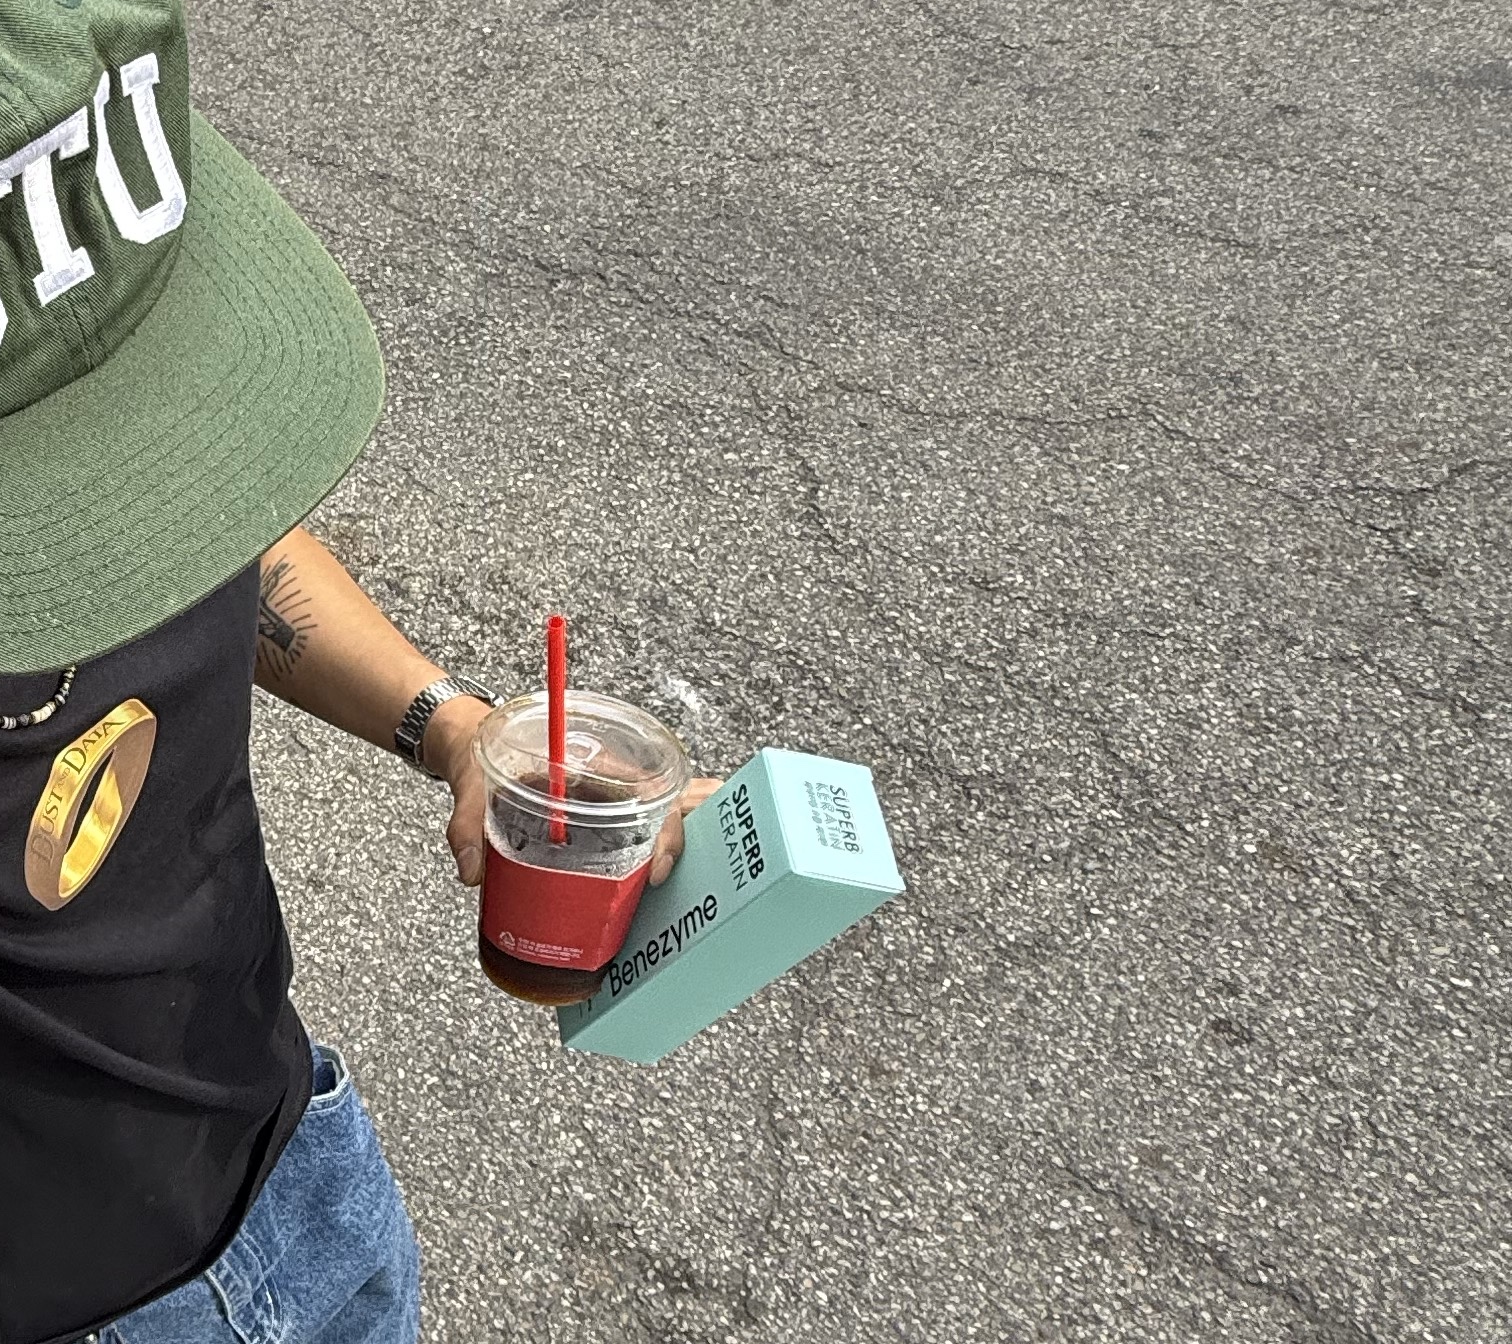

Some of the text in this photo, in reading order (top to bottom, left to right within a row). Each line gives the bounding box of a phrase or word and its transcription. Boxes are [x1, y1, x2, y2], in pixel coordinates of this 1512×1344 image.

[717, 797, 748, 892] KERATIN
[732, 783, 765, 880] SUPERB
[815, 782, 845, 852] KERATIN
[830, 784, 862, 855] SUPERB
[608, 894, 718, 998] Benezyme
